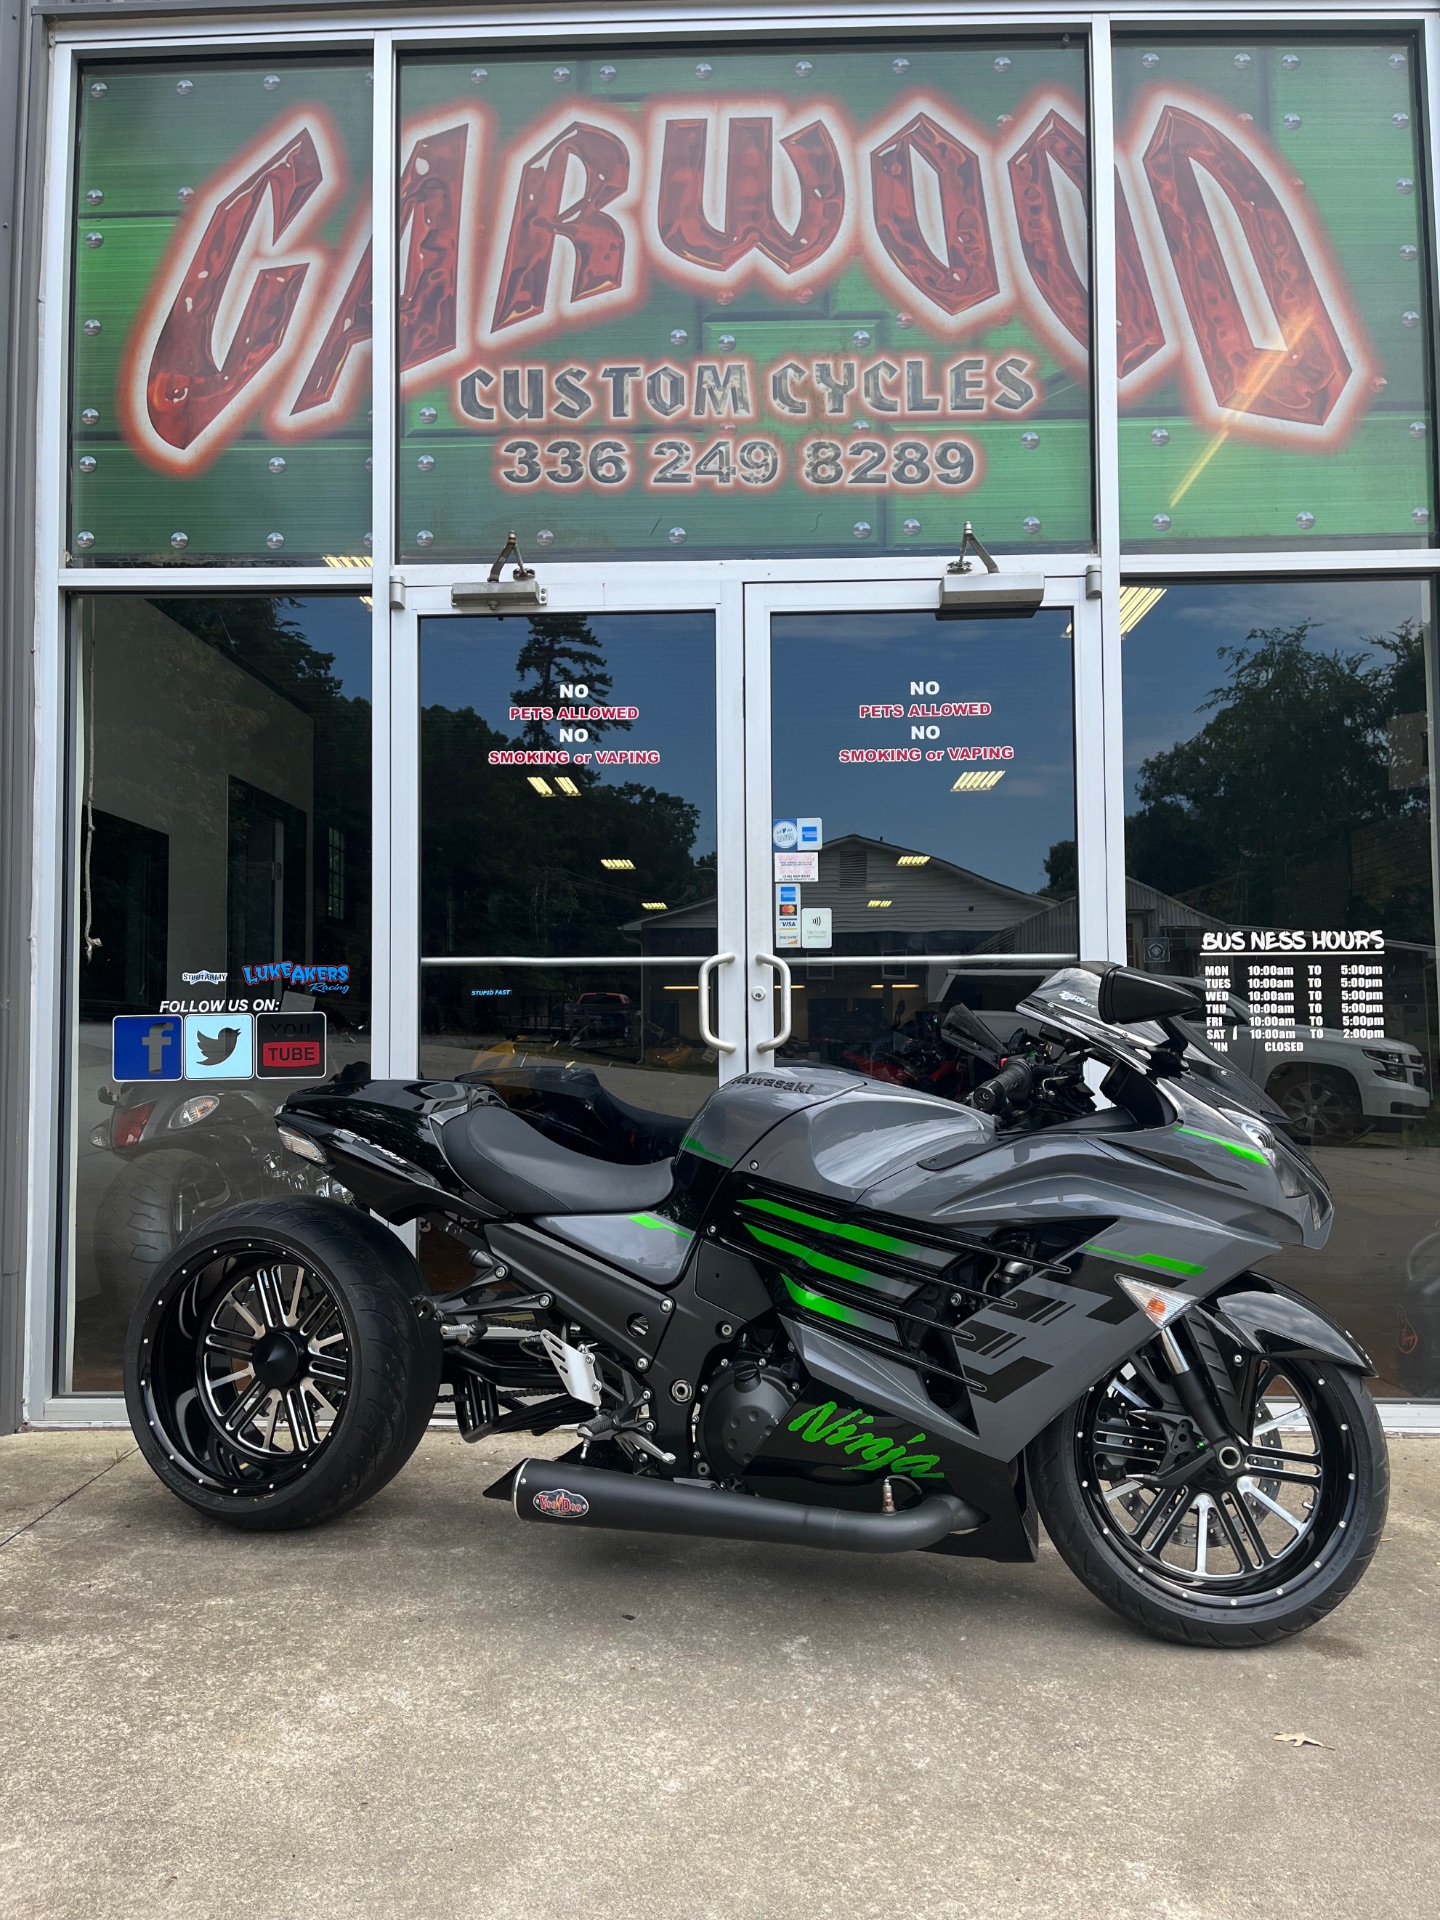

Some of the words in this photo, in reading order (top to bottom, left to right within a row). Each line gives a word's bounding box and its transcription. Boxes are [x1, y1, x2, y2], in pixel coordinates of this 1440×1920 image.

[147, 105, 1352, 450] GARWOOD
[460, 364, 751, 419] CUSTOM
[771, 358, 1035, 415] CYCLES
[502, 440, 629, 485] 336
[652, 440, 779, 485] 249
[803, 439, 975, 485] 8289
[559, 684, 589, 699] NO
[909, 681, 940, 696] NO
[509, 706, 554, 721] PETS
[556, 706, 640, 721] ALLOWED
[859, 704, 905, 719] PETS
[907, 702, 992, 718] ALLOWED
[559, 728, 589, 743] NO
[910, 725, 941, 740] NO
[488, 750, 570, 765] SMOKING
[573, 753, 592, 765] or
[594, 750, 661, 764] VAPING
[838, 747, 922, 763] SMOKING
[925, 750, 945, 762] or
[946, 745, 1015, 761] VAPING
[1311, 930, 1385, 950] HOURS
[242, 960, 293, 985] LUKE
[290, 964, 350, 985] AKERS
[1205, 966, 1229, 976] MON
[1248, 966, 1294, 976] 10:00am
[1308, 965, 1322, 975] TO
[1340, 965, 1383, 977] 5:00pm
[309, 982, 350, 994] Racing
[1205, 978, 1231, 989] TUES
[1248, 978, 1294, 988] 10:00am
[1308, 977, 1322, 987] TO
[1340, 977, 1383, 990] 5:00pm
[1205, 991, 1229, 1001] WED
[1248, 991, 1295, 1001] 10:00am
[1308, 990, 1322, 1000] TO
[1341, 990, 1384, 1003] 5:00pm
[159, 1000, 225, 1013] FOLLOW
[228, 1000, 249, 1012] US
[252, 999, 280, 1012] ON:
[1206, 1003, 1227, 1014] THU
[1248, 1003, 1295, 1014] 10:00am
[1308, 1002, 1322, 1013] TO
[1341, 1002, 1384, 1016] 5:00pm
[1206, 1016, 1223, 1027] FRI
[1249, 1016, 1296, 1026] 10:00am
[1309, 1015, 1323, 1025] TO
[1342, 1015, 1385, 1028] 5:00pm
[270, 1023, 312, 1038] YOU
[1206, 1029, 1226, 1039] SAT
[1250, 1029, 1296, 1039] 10:00am
[1310, 1028, 1324, 1038] TO
[1342, 1028, 1385, 1041] 2:00pm
[268, 1047, 316, 1062] TUBE
[1264, 1042, 1304, 1052] CLOSED
[731, 1077, 814, 1095] Kawasaki
[788, 1401, 944, 1478] Ninja
